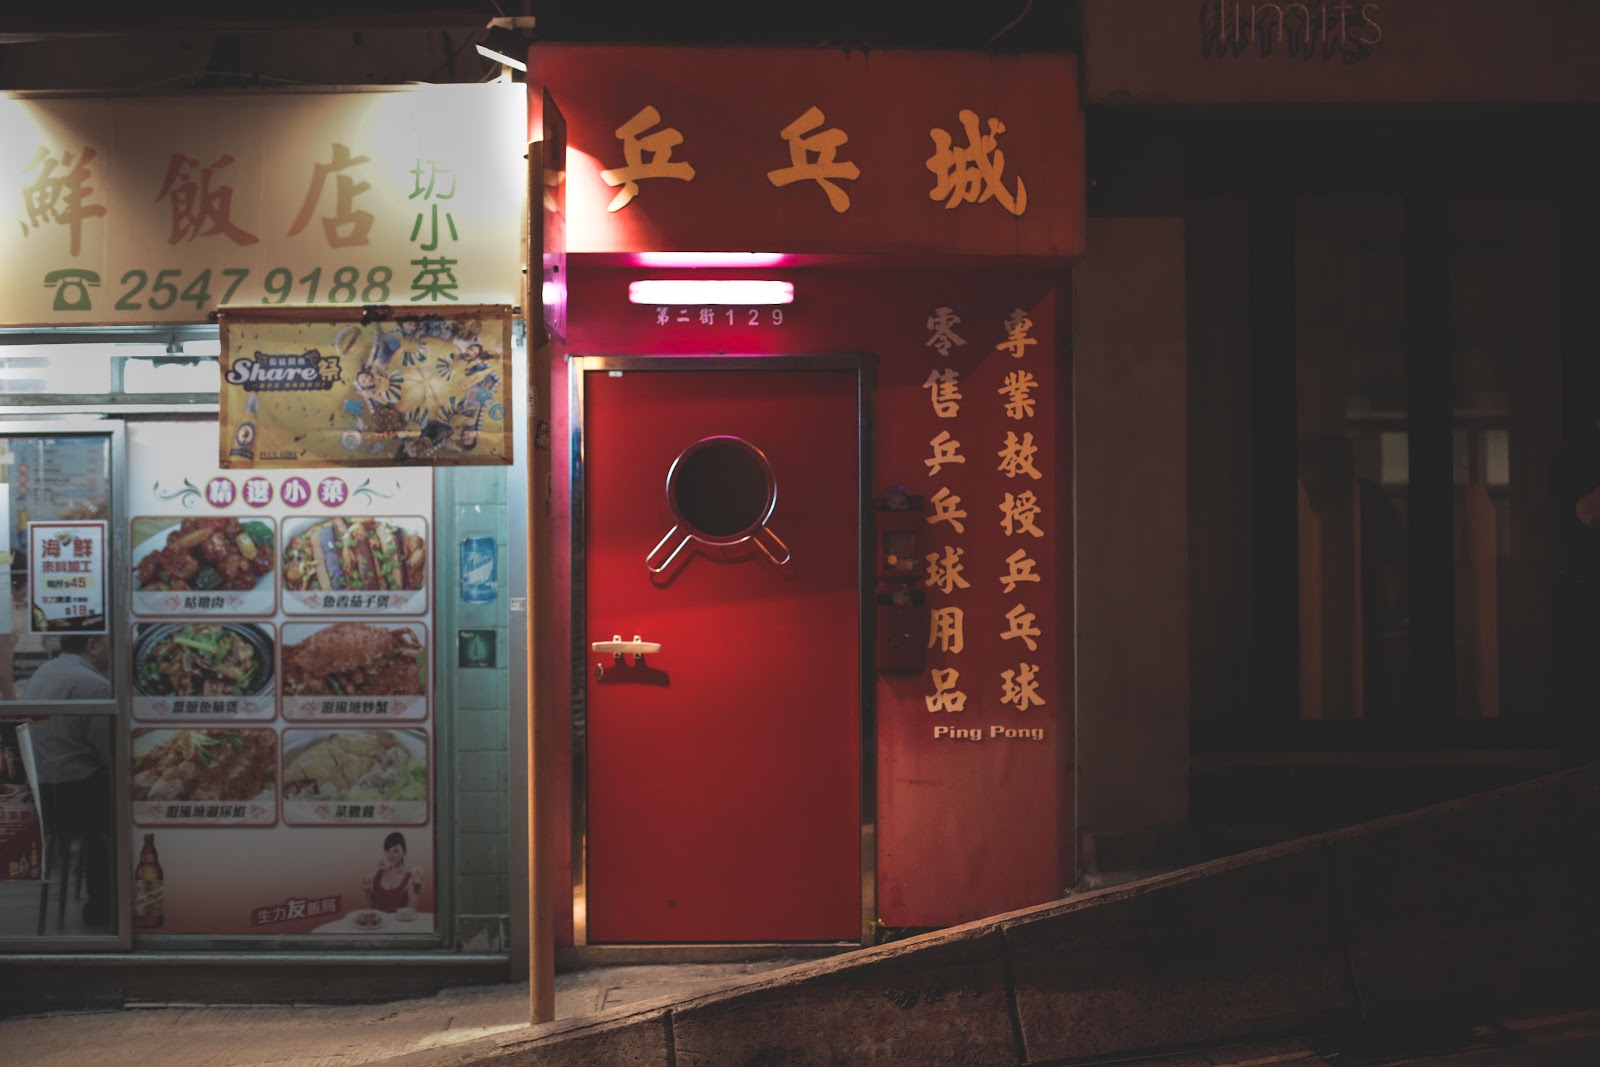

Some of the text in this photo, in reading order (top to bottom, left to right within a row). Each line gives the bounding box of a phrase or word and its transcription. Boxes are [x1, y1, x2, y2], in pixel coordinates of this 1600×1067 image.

[1219, 0, 1382, 44] limits
[600, 105, 1027, 216] 乒乓城
[19, 142, 376, 257] 鮮飯店
[114, 265, 393, 311] 2547 9188
[227, 359, 318, 384] Share
[207, 479, 345, 505] 精選小菜
[922, 306, 970, 713] 零售乒乓球用品
[42, 538, 92, 557] 海鮮
[934, 726, 1044, 740] Ping Pong
